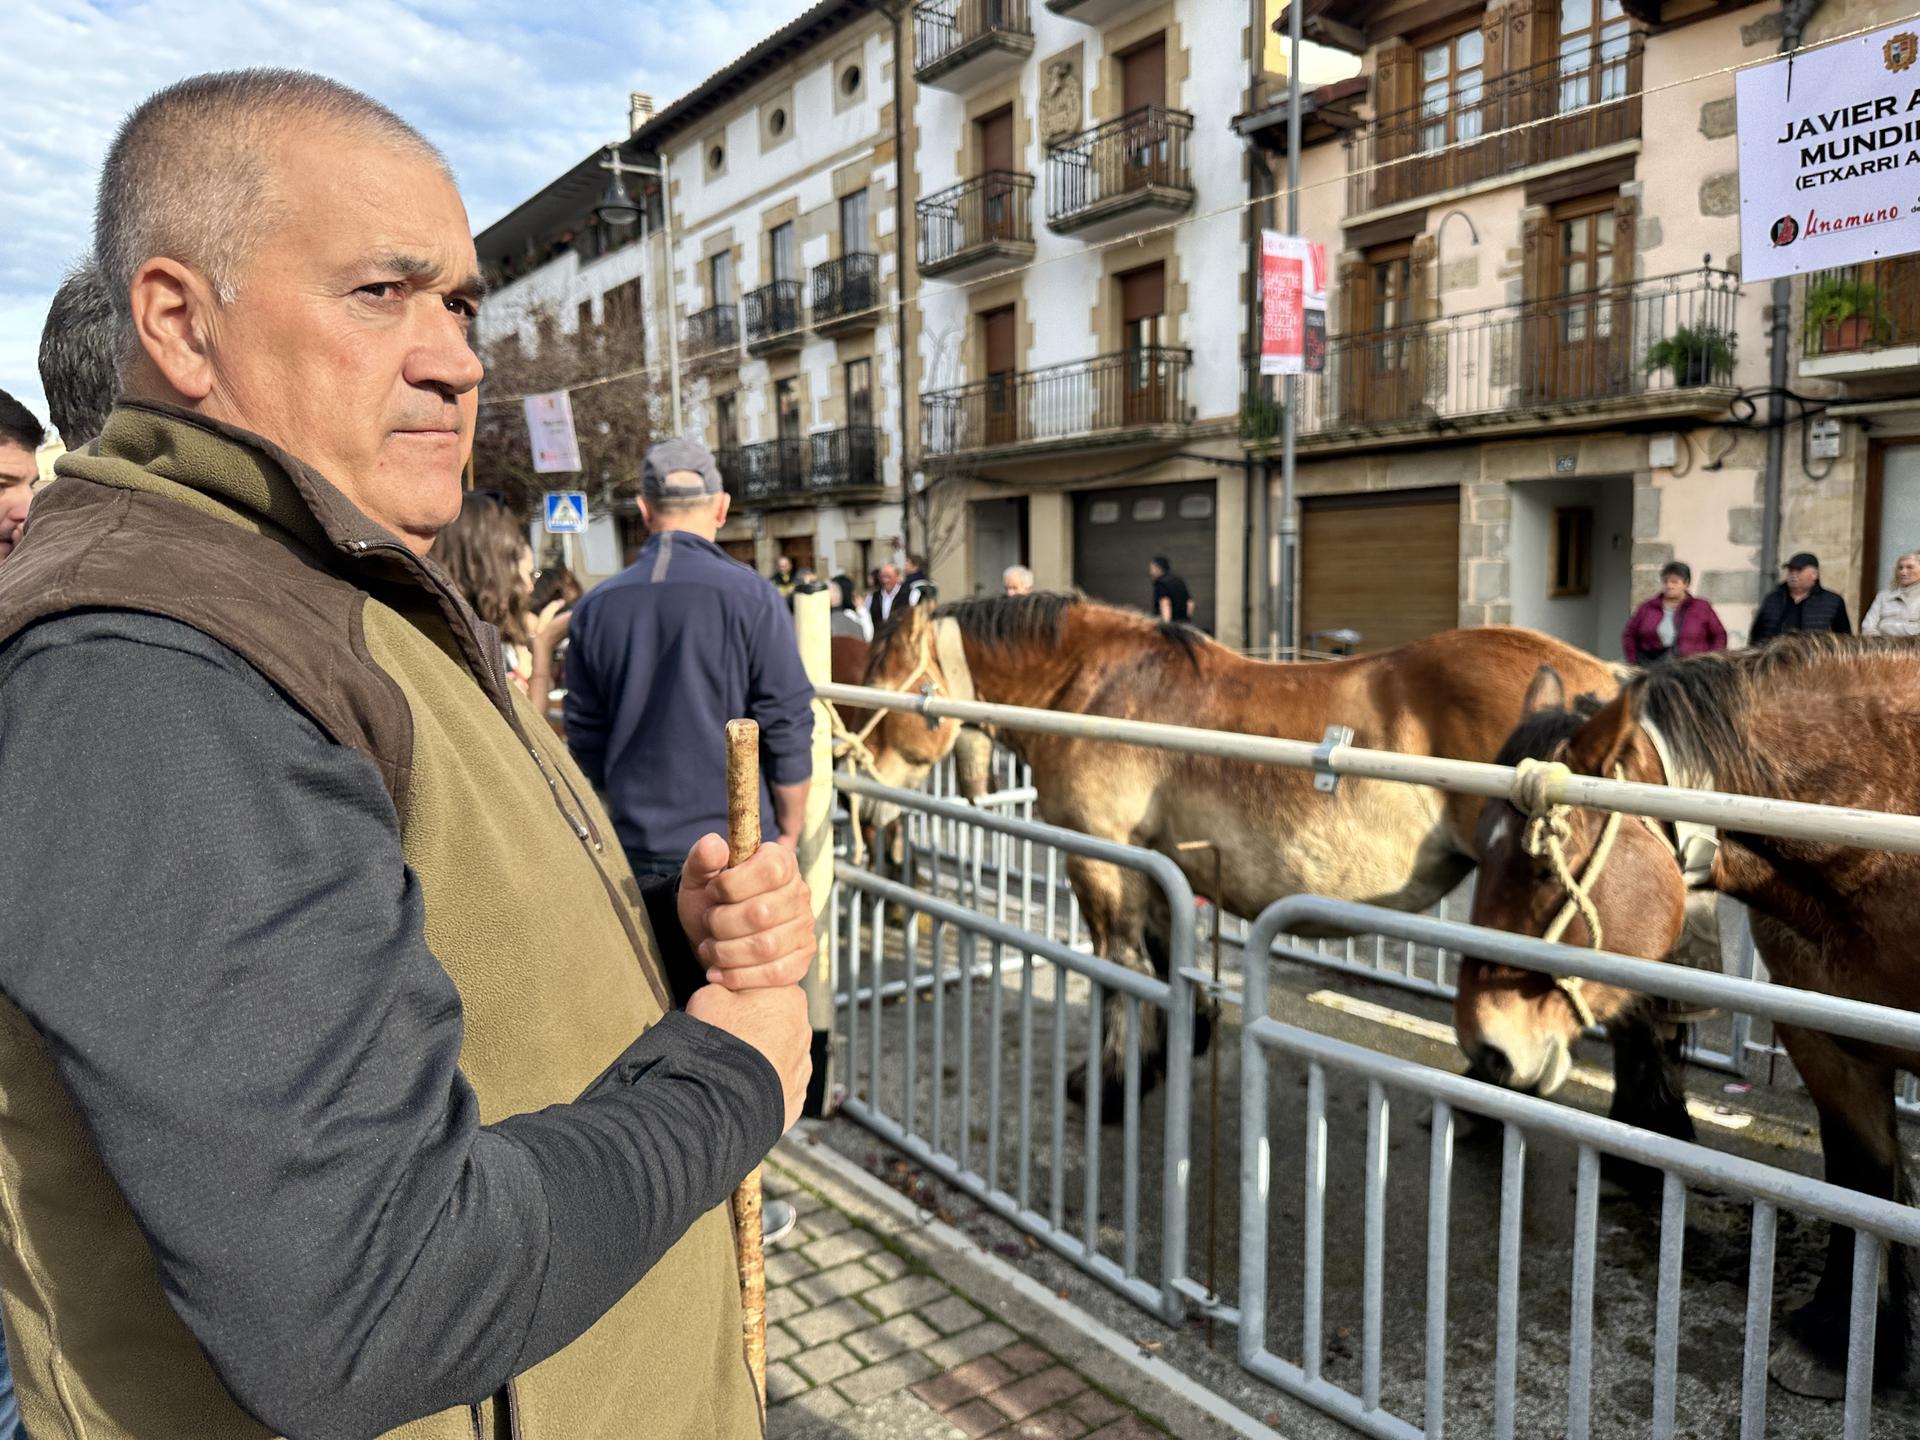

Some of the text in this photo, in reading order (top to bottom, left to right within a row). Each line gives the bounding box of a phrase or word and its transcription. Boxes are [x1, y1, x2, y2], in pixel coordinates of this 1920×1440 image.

[1777, 96, 1898, 144] JAVIER
[1796, 153, 1900, 191] (ETXARRI
[1803, 206, 1899, 240] Unamuno
